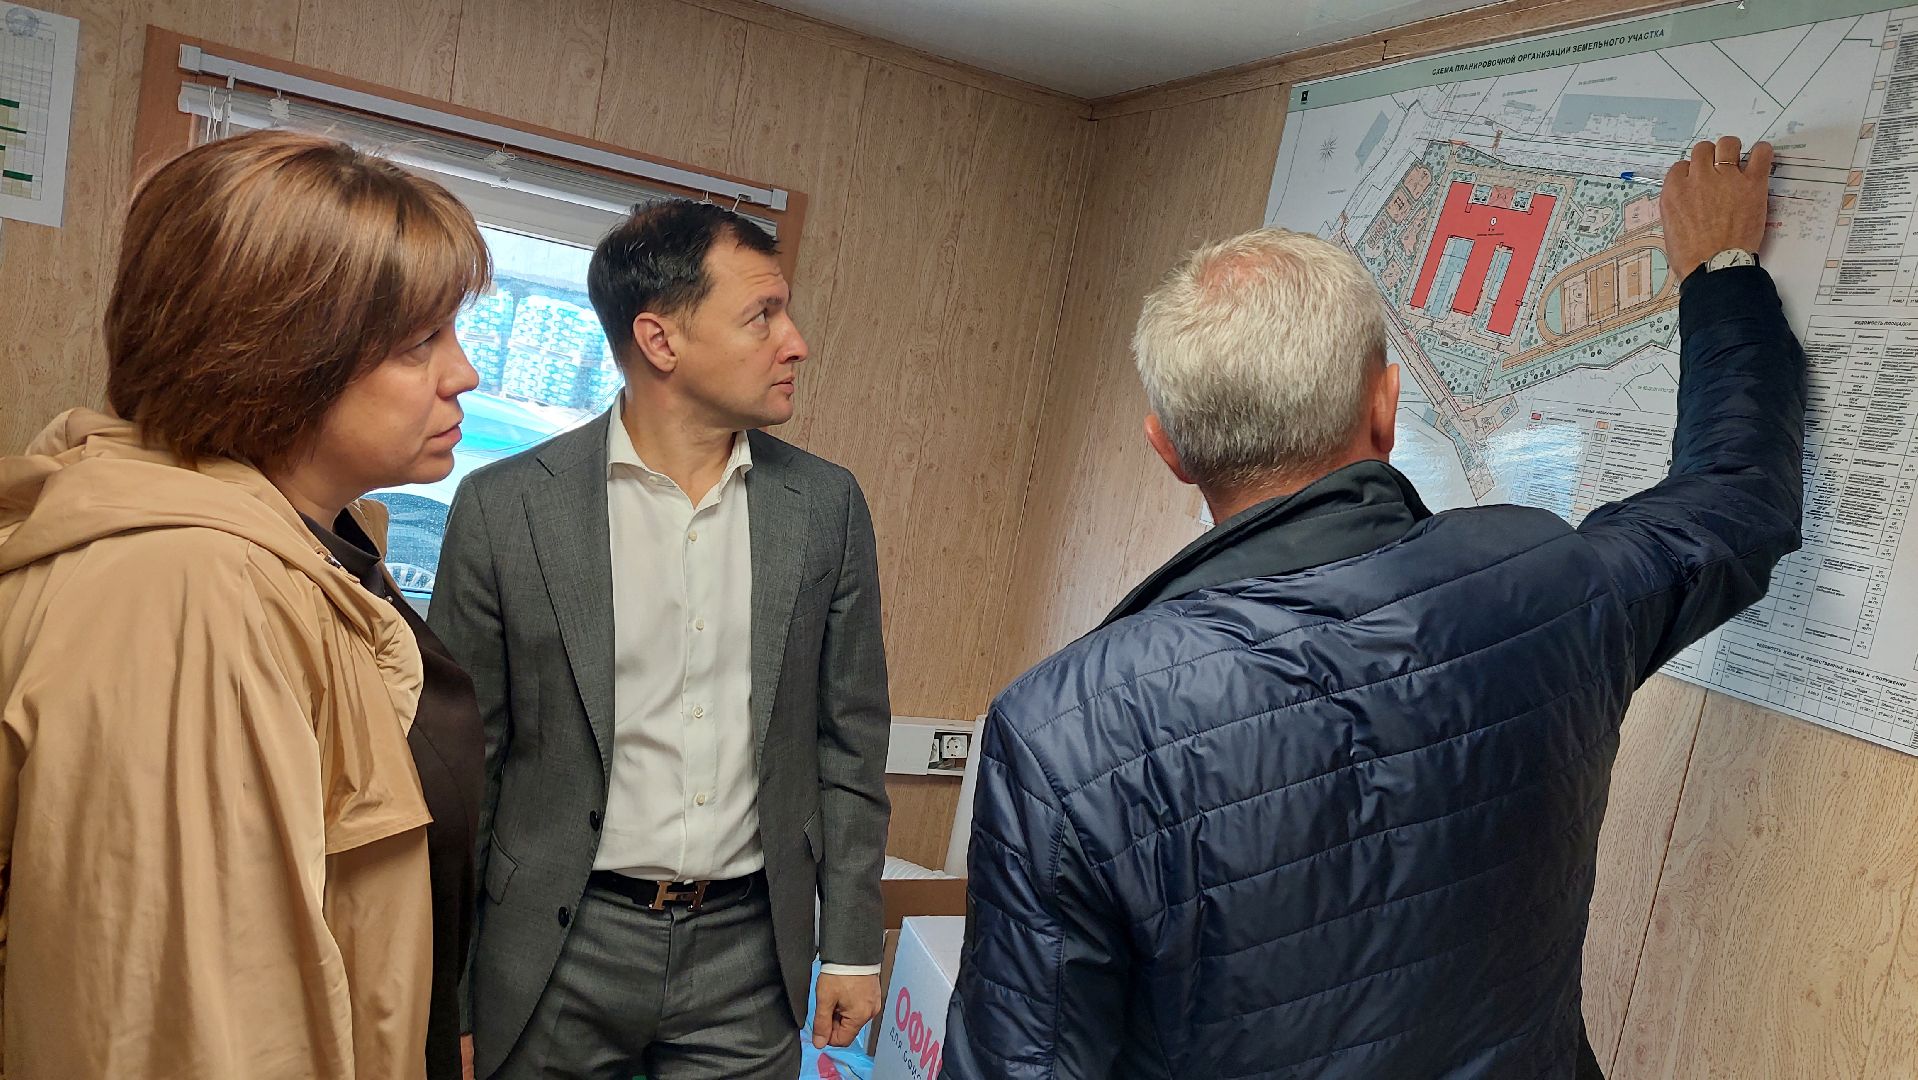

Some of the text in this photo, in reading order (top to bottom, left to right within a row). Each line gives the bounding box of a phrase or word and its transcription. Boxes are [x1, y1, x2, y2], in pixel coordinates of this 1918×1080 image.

[1432, 28, 1665, 76] СХЕМА ПЛАНИРОВОЧНОЙ ОРГАНИЗАЦИИ ЗЕМЕЛЬНОГО УЧАСТКА
